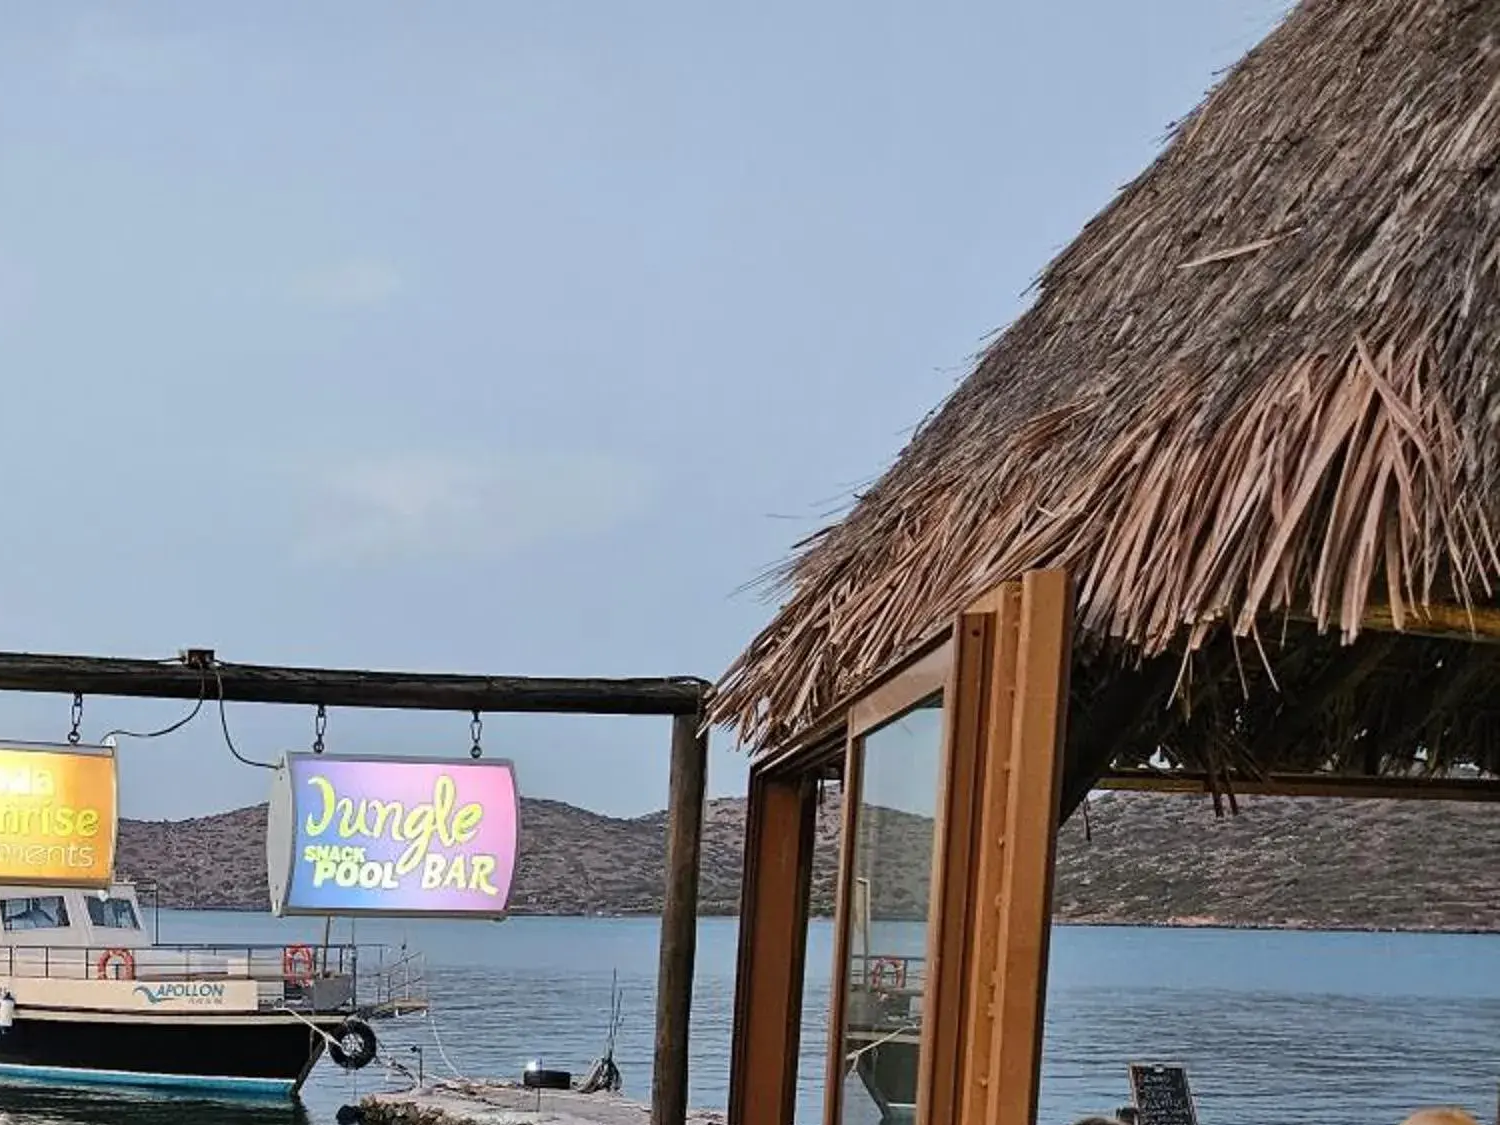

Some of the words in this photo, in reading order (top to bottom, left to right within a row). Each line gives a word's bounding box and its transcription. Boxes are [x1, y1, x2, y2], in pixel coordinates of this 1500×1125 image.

[305, 774, 483, 874] Jungle
[304, 845, 366, 862] SNACK
[312, 860, 400, 889] POOL
[421, 854, 499, 896] BAR
[156, 983, 225, 997] APOLLON
